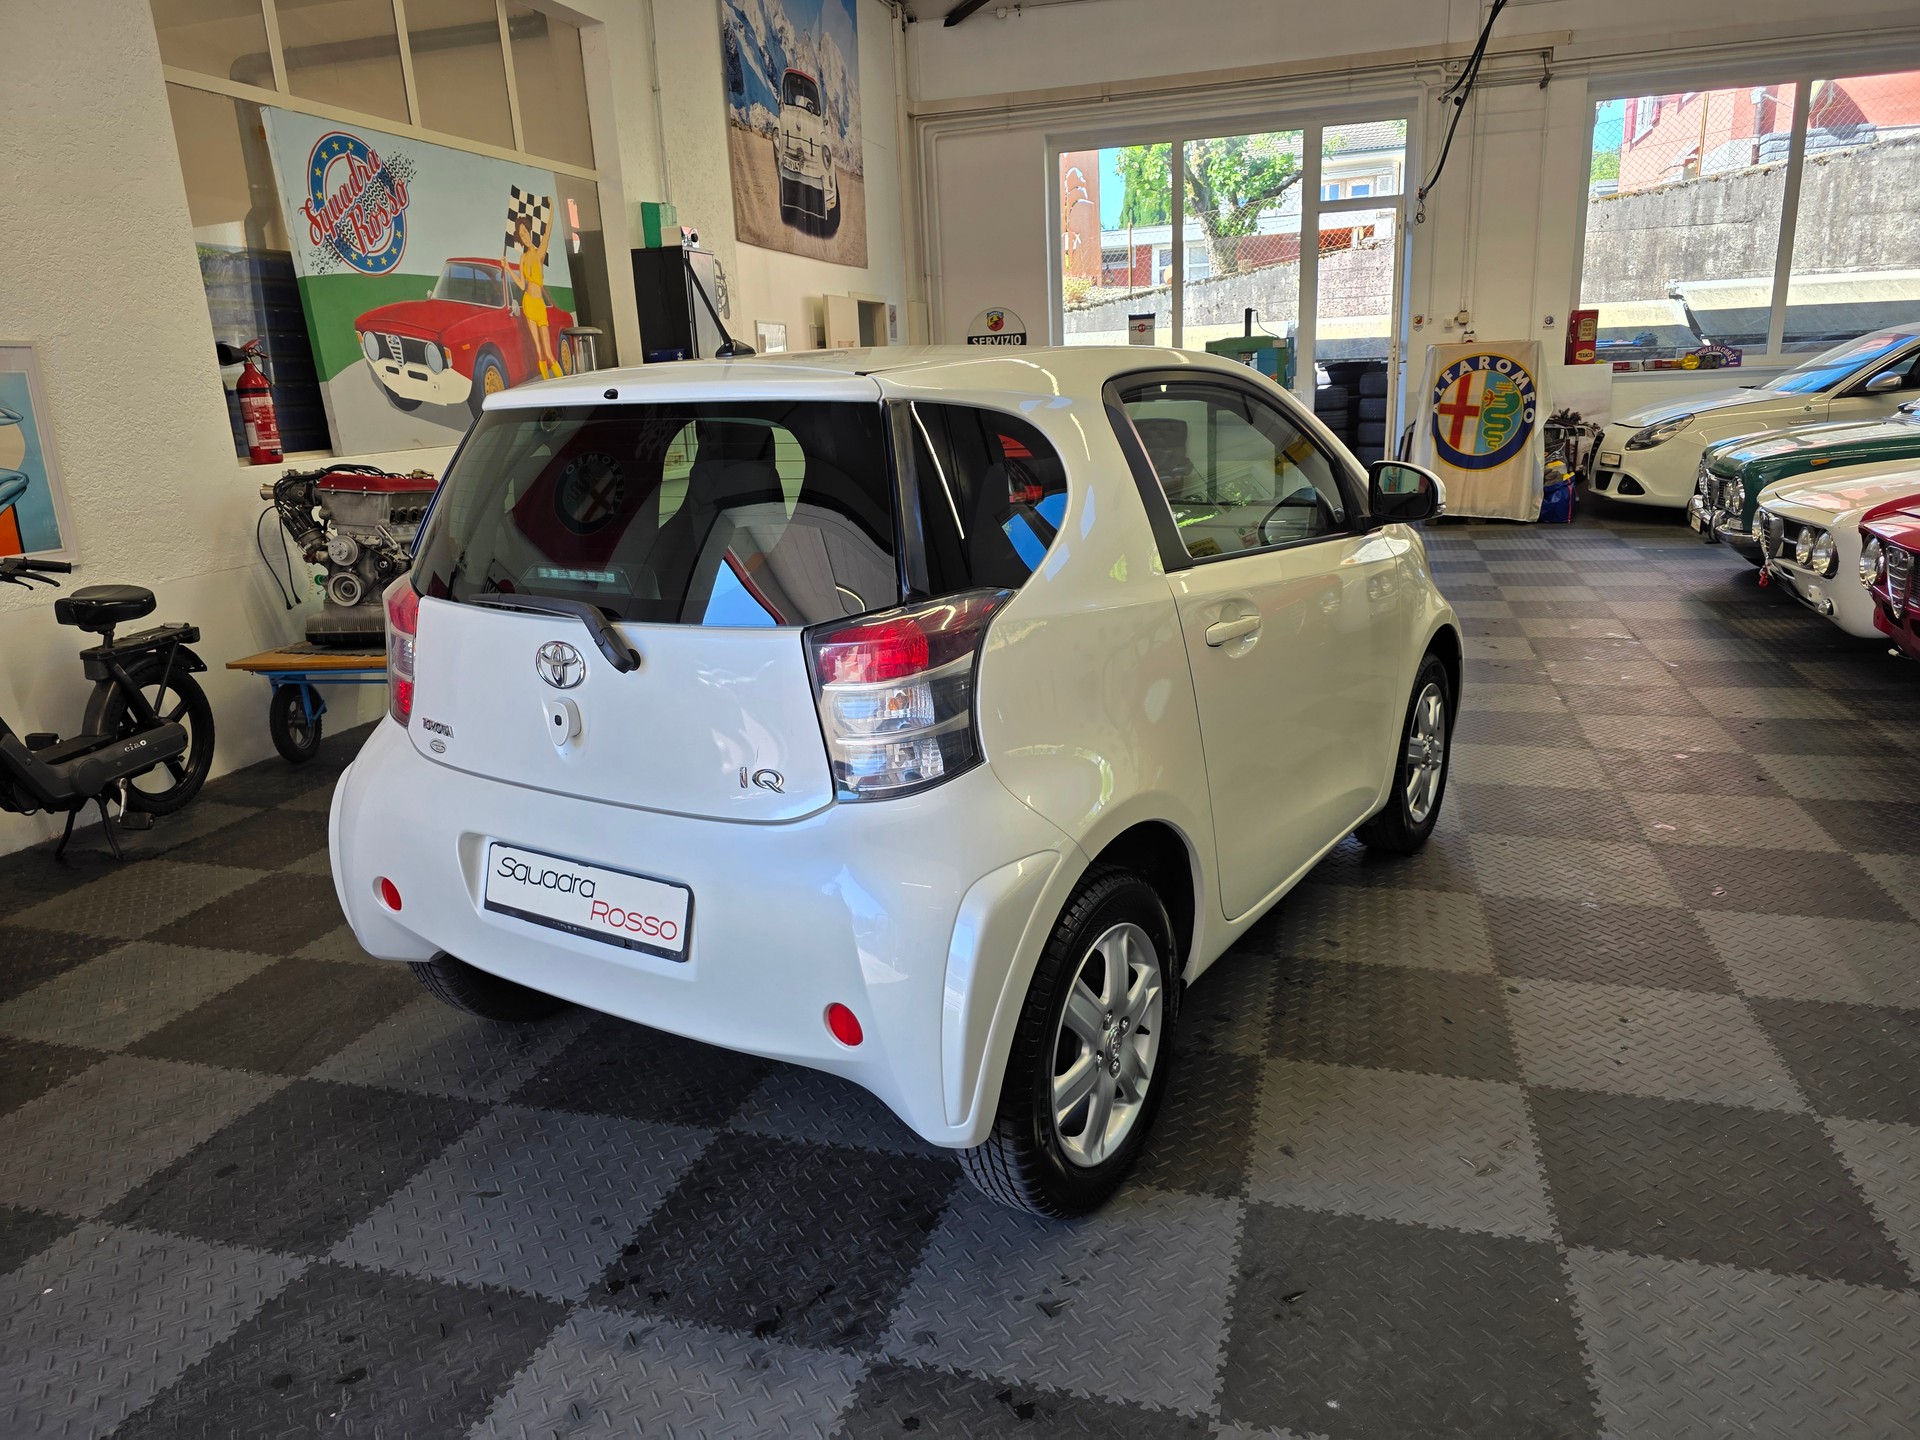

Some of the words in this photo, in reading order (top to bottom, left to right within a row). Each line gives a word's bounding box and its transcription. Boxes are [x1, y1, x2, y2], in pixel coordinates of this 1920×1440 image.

[298, 149, 381, 247] Squadra
[347, 178, 409, 257] Rosso
[972, 335, 1022, 345] SERVIZIO
[124, 740, 147, 752] ciao
[497, 856, 596, 899] Squadra
[590, 899, 678, 941] ROSSO
